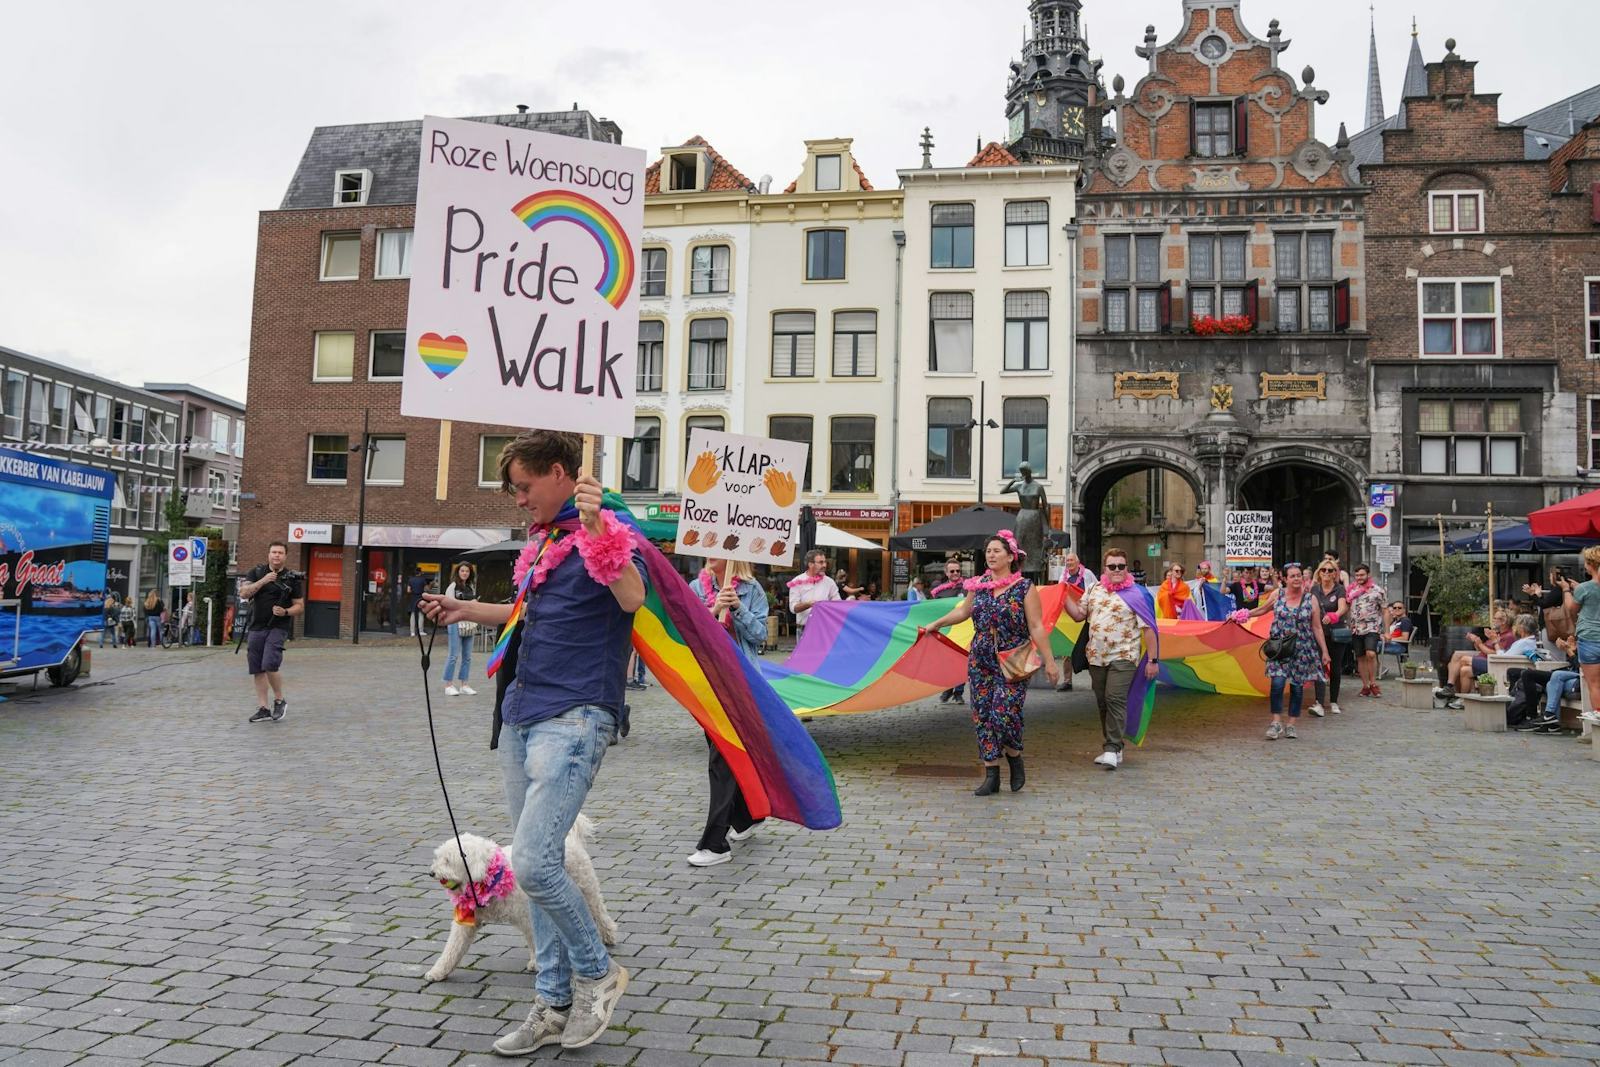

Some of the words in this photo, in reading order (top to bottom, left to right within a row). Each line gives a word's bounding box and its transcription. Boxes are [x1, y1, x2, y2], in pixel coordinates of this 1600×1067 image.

[430, 129, 498, 171] Roze
[442, 204, 579, 305] Pride
[722, 444, 771, 476] KLAP
[0, 455, 39, 480] KKERBEK
[41, 464, 60, 484] VAN
[61, 468, 106, 492] KABELJAUW
[724, 481, 756, 494] voor
[683, 498, 719, 524] Roze
[1226, 512, 1255, 525] QUEER
[1226, 533, 1251, 541] SHOULD
[1227, 525, 1272, 534] AFFECTION
[1226, 547, 1272, 556] AVERSION
[15, 550, 65, 597] Graat
[375, 571, 385, 580] FL
